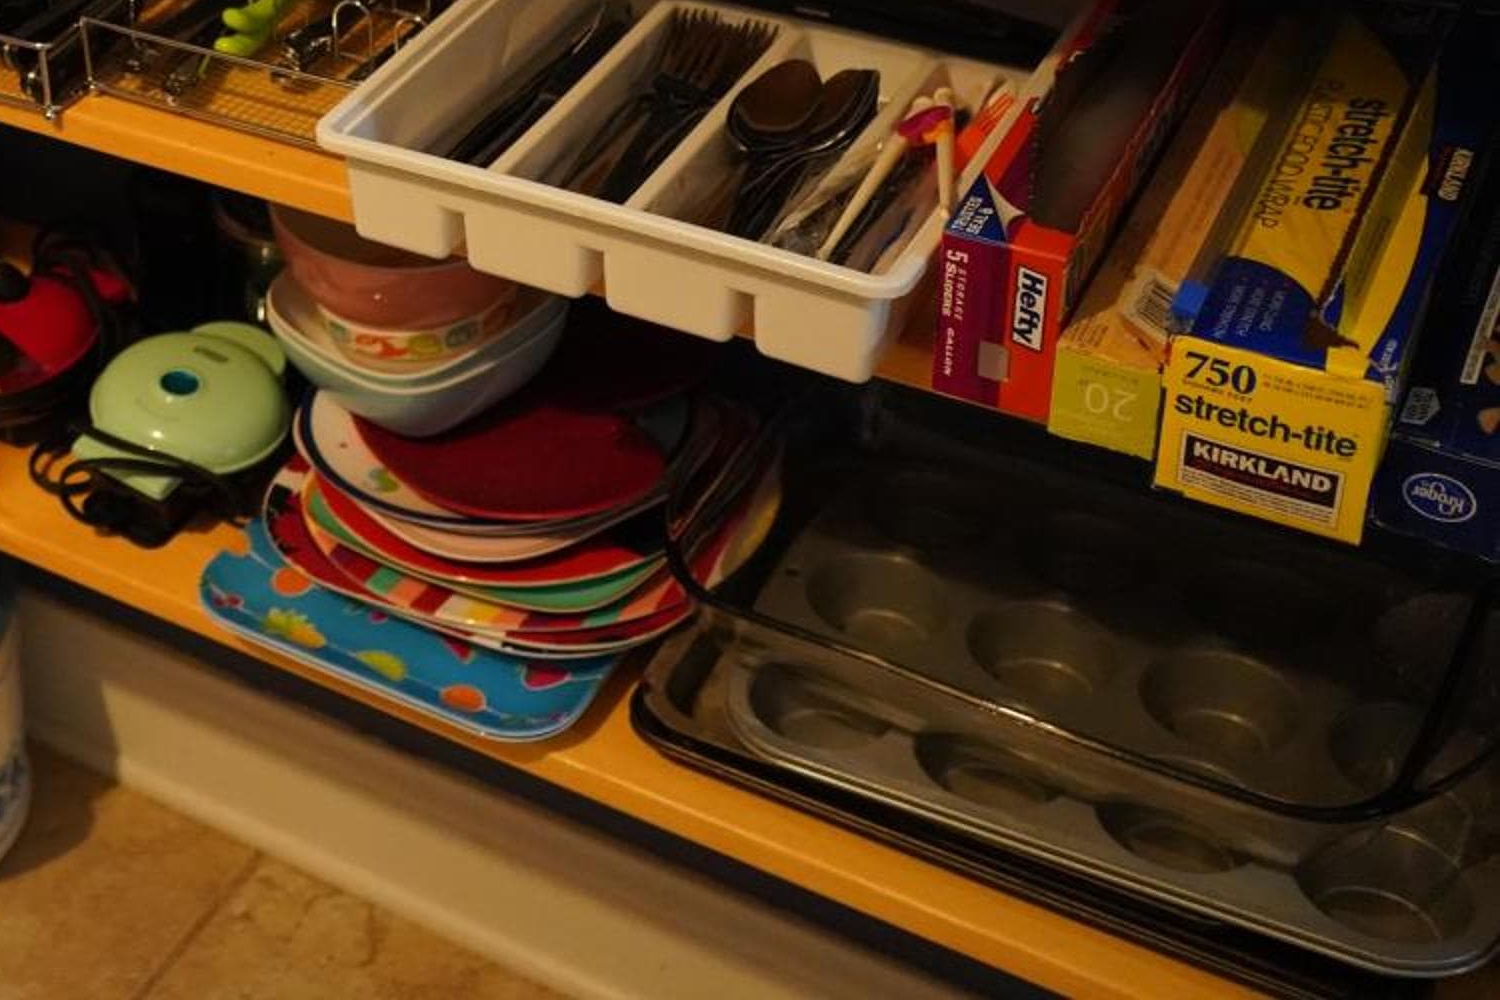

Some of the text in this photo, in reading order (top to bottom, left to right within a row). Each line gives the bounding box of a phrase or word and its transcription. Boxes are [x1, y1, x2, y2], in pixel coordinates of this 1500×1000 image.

[1303, 97, 1391, 211] stretch-tite
[945, 248, 969, 265] 5
[1013, 273, 1044, 345] Hefty
[1184, 350, 1257, 395] 750
[1085, 382, 1139, 422] 20
[1174, 392, 1358, 457] stretch-tite
[1191, 440, 1333, 493] KIRKLAND
[1411, 478, 1465, 516] Kroger
